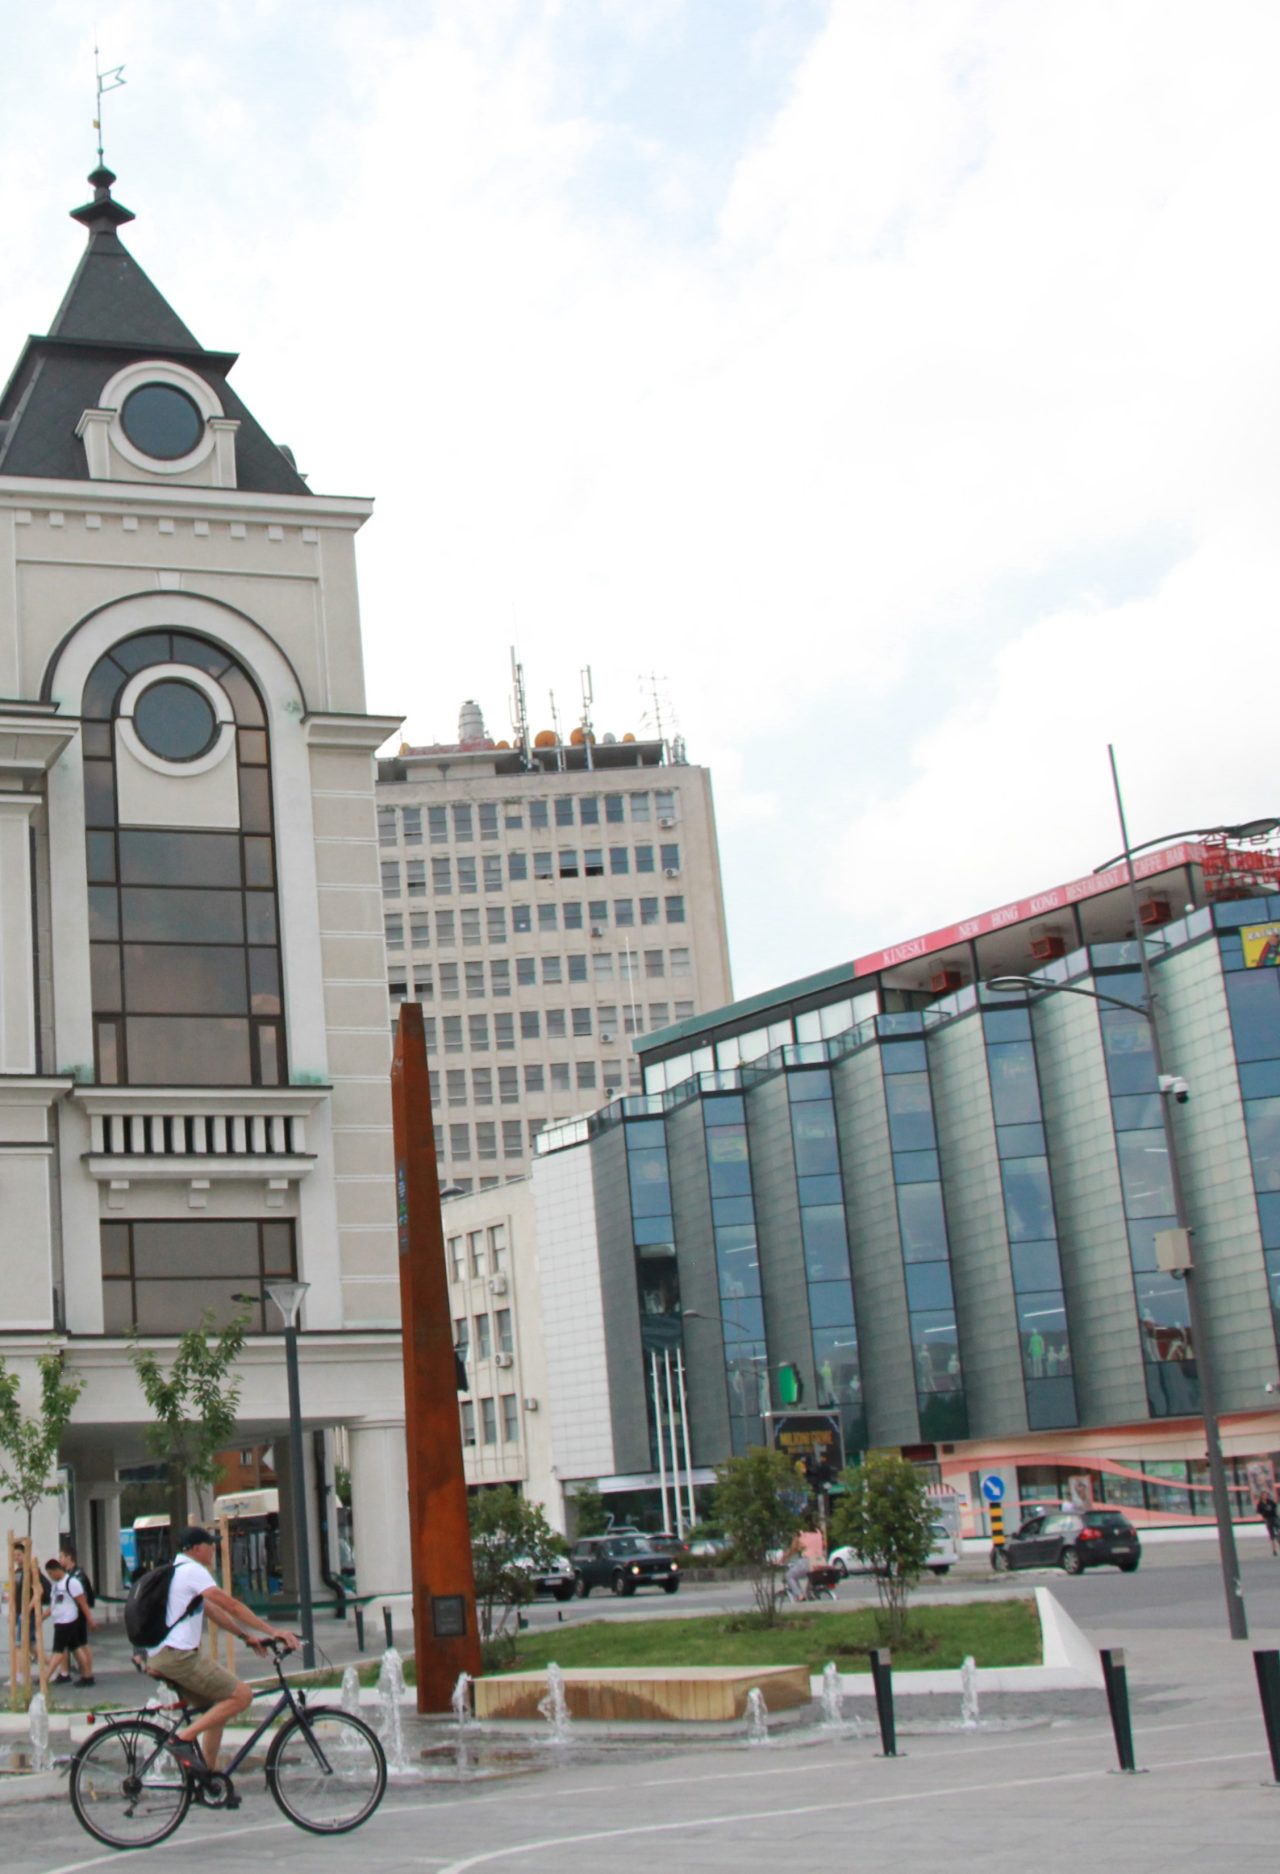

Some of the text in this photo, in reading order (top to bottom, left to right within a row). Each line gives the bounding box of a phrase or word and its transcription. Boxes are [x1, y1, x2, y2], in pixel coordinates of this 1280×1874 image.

[882, 937, 926, 966] KINESKI
[957, 920, 980, 937] NEW
[991, 906, 1019, 928] HONG
[1029, 891, 1059, 914] KONG
